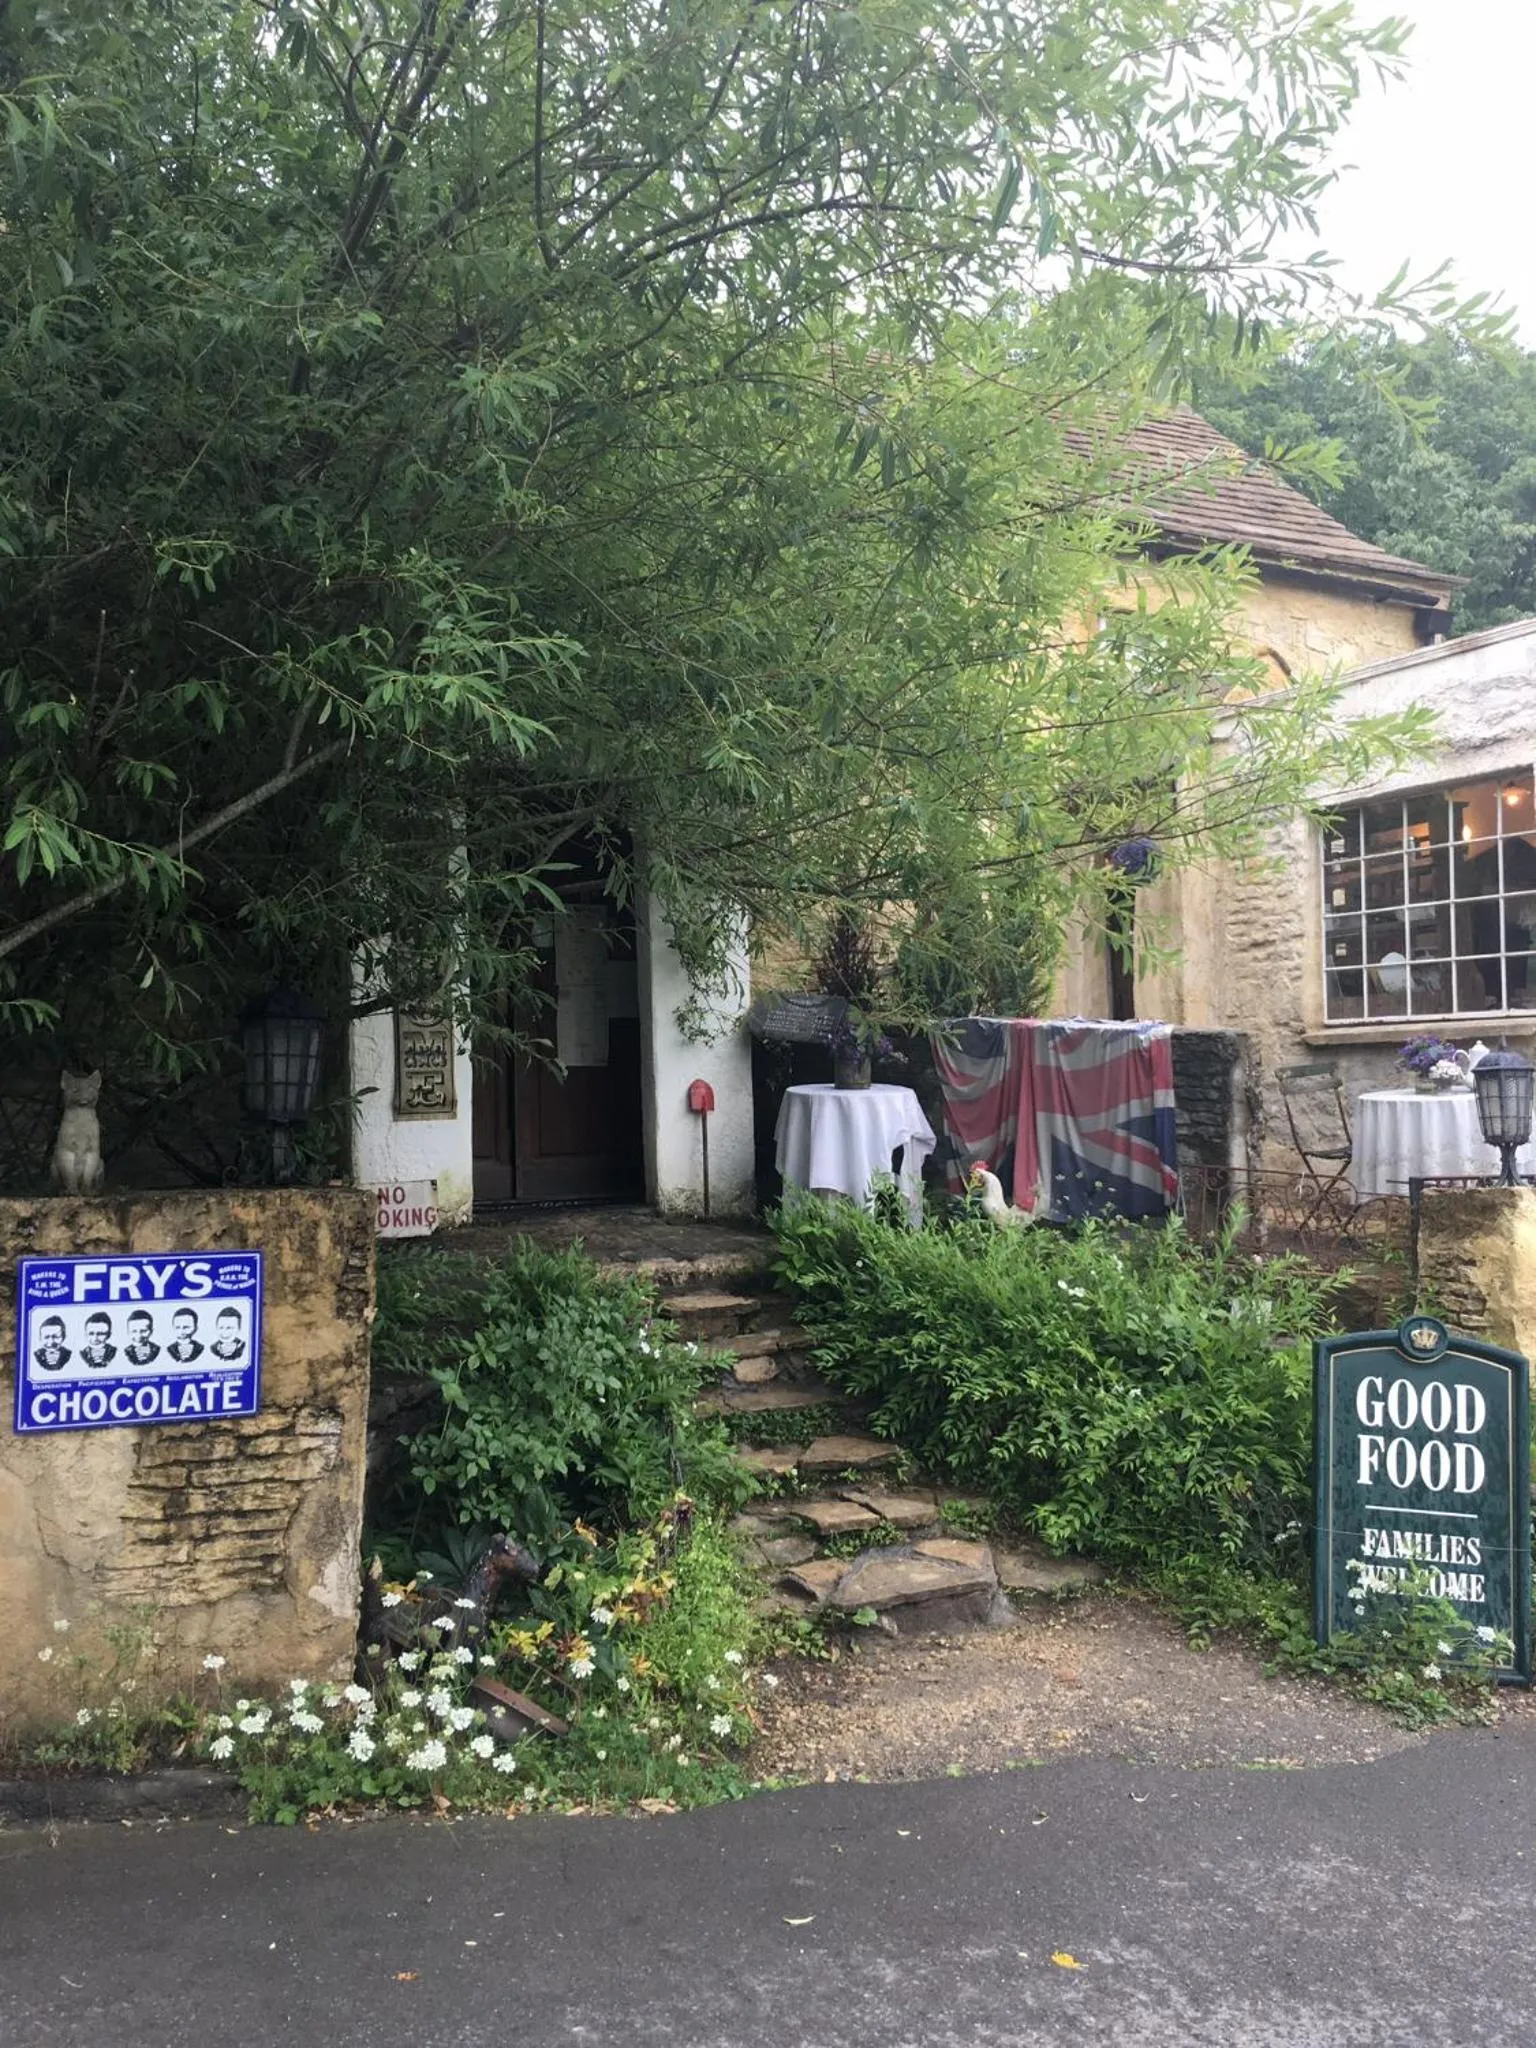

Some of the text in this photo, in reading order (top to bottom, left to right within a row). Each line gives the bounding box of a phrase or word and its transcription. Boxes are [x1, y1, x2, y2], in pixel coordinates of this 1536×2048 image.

[377, 1186, 405, 1205] NO
[377, 1206, 437, 1228] OKING
[73, 1260, 213, 1302] FRY'S
[31, 1381, 243, 1424] CHOCOLATE
[1355, 1375, 1487, 1435] GOOD
[1356, 1434, 1486, 1494] FOOD
[1362, 1527, 1481, 1566] FAMILIES
